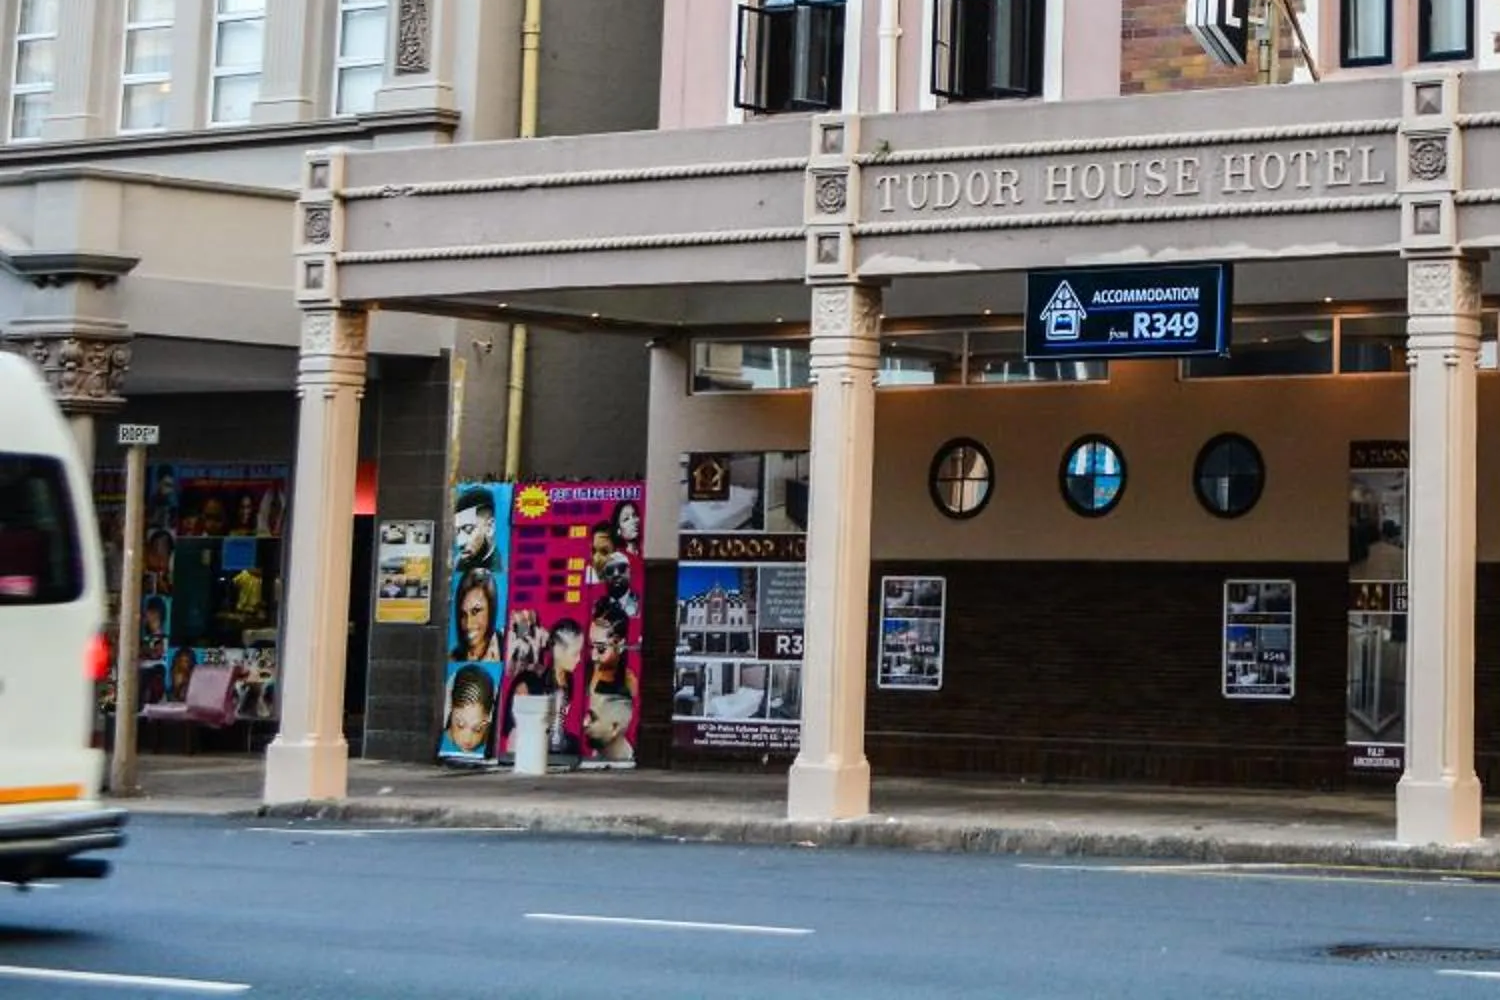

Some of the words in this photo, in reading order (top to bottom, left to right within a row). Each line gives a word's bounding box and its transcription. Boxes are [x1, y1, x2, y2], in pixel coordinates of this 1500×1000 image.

[876, 168, 1023, 214] TUDOR
[1045, 156, 1201, 204] HOUSE
[1221, 145, 1386, 194] HOTEL
[1091, 286, 1200, 304] ACCOMMODATION
[1133, 311, 1200, 340] R349
[709, 537, 775, 557] TUDOR
[776, 634, 804, 656] R3
